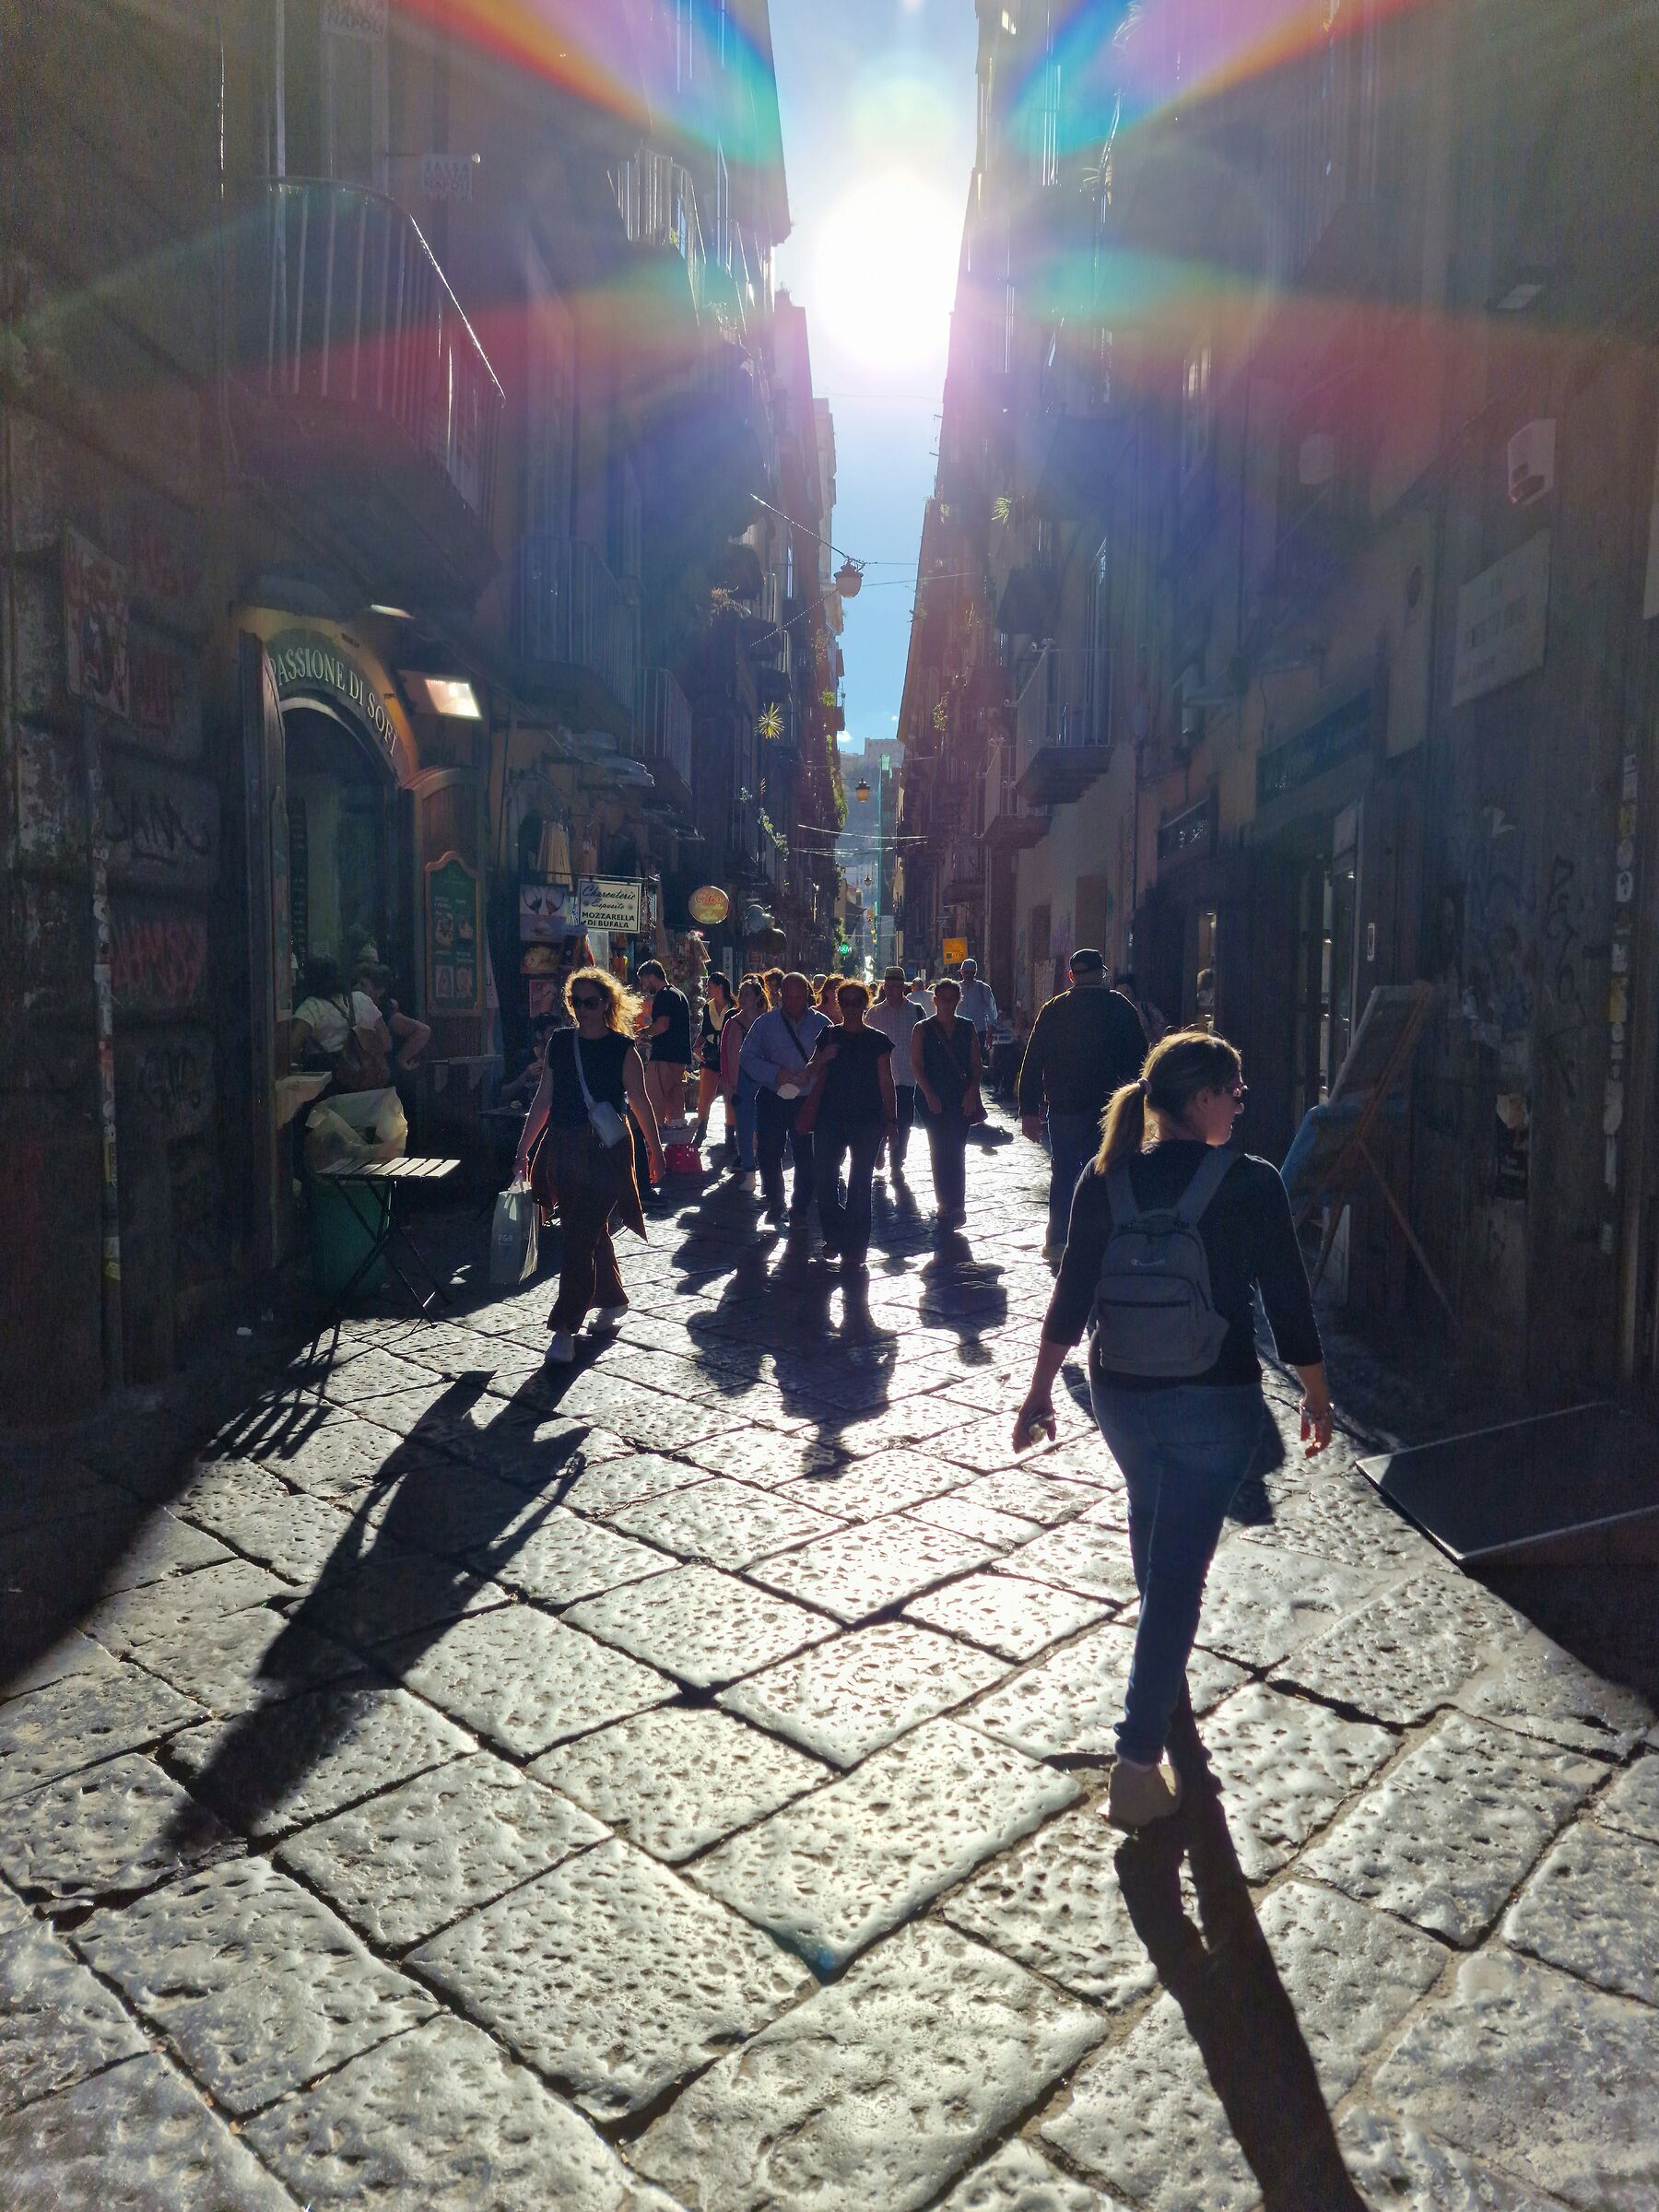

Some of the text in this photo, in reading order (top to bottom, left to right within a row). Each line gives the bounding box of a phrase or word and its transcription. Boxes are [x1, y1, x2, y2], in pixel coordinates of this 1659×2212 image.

[327, 10, 383, 35] NAPOLI
[349, 670, 364, 707] DI
[582, 912, 635, 922] MOZZARELLA
[597, 920, 629, 929] BUFALA
